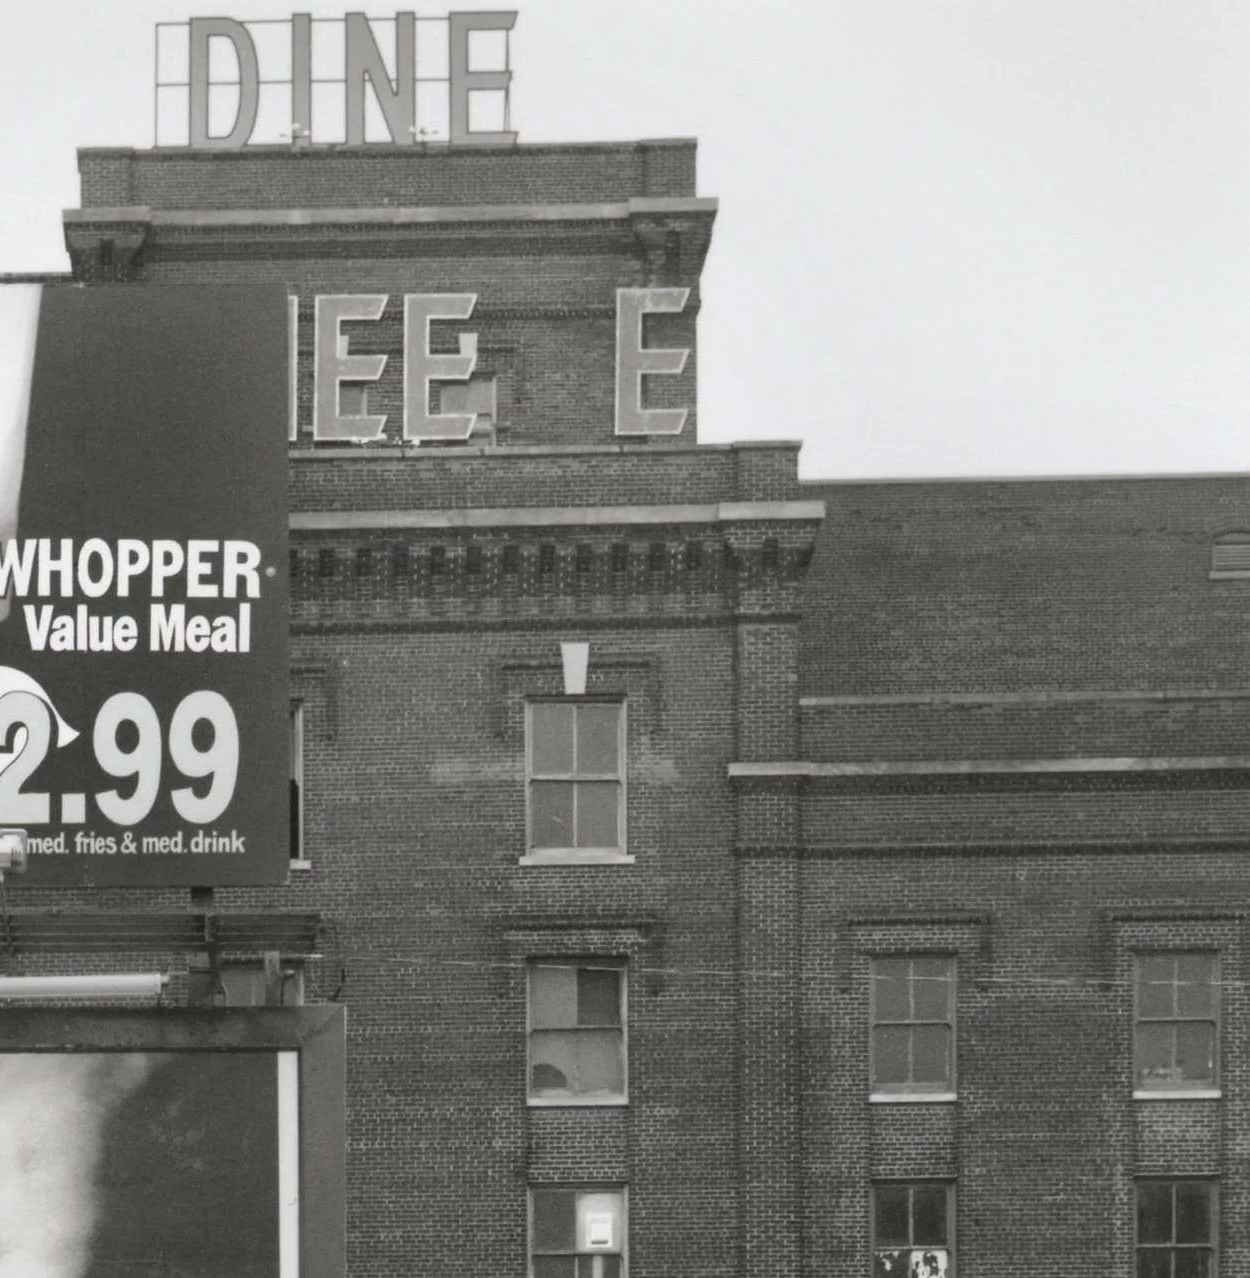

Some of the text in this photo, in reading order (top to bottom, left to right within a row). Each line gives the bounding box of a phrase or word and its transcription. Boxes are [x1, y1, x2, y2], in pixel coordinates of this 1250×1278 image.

[188, 11, 519, 149] DINE
[23, 603, 251, 653] Value Meal
[27, 829, 246, 854] med. fries & med. drink
